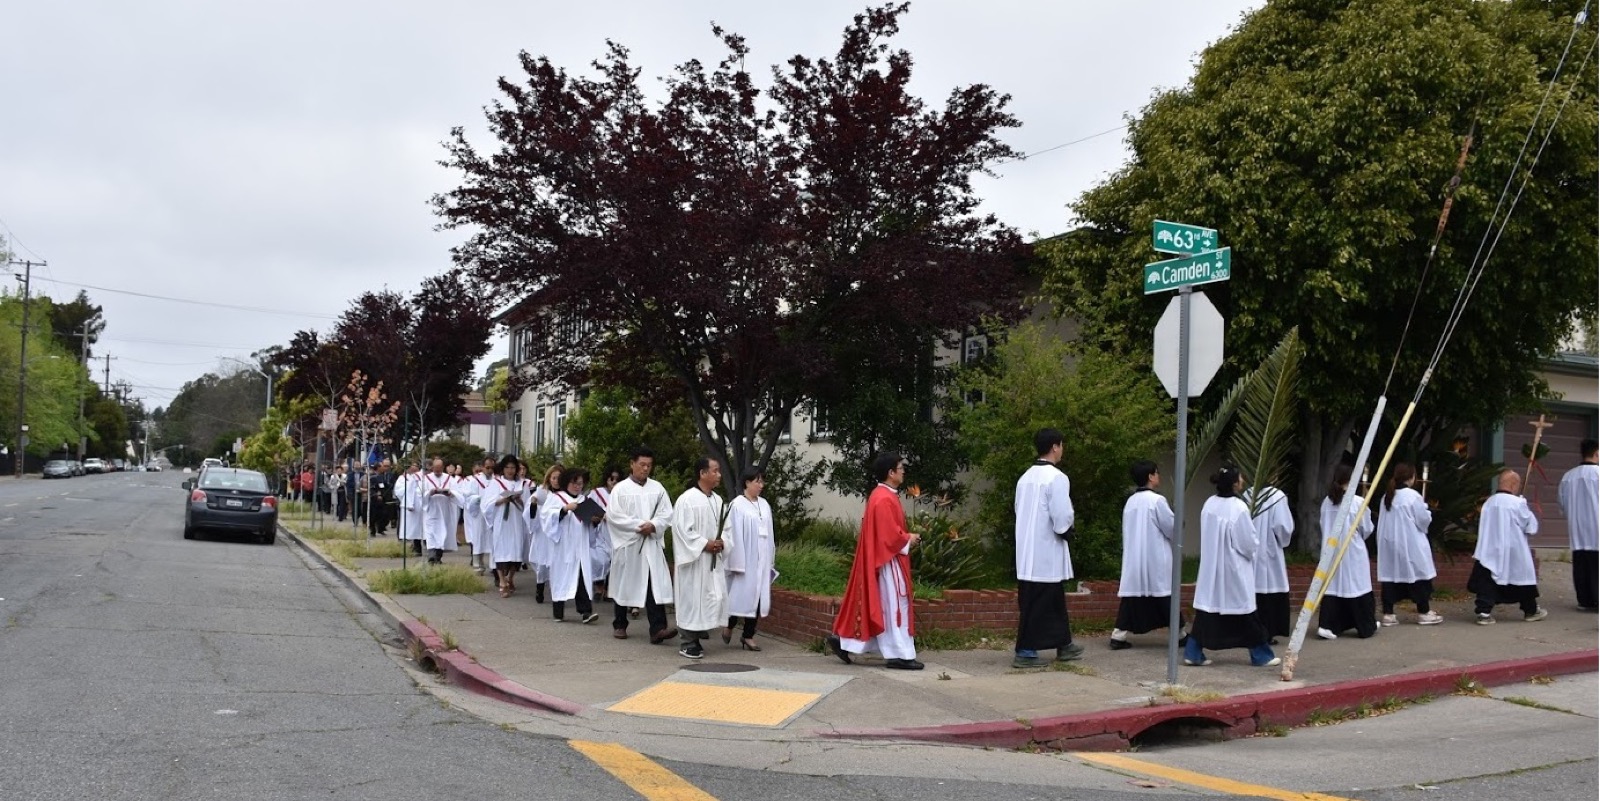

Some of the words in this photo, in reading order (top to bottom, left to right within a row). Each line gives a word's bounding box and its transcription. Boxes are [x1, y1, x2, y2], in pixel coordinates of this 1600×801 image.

[1201, 230, 1214, 239] AVE
[1162, 261, 1210, 284] Camden
[1216, 251, 1223, 260] ST
